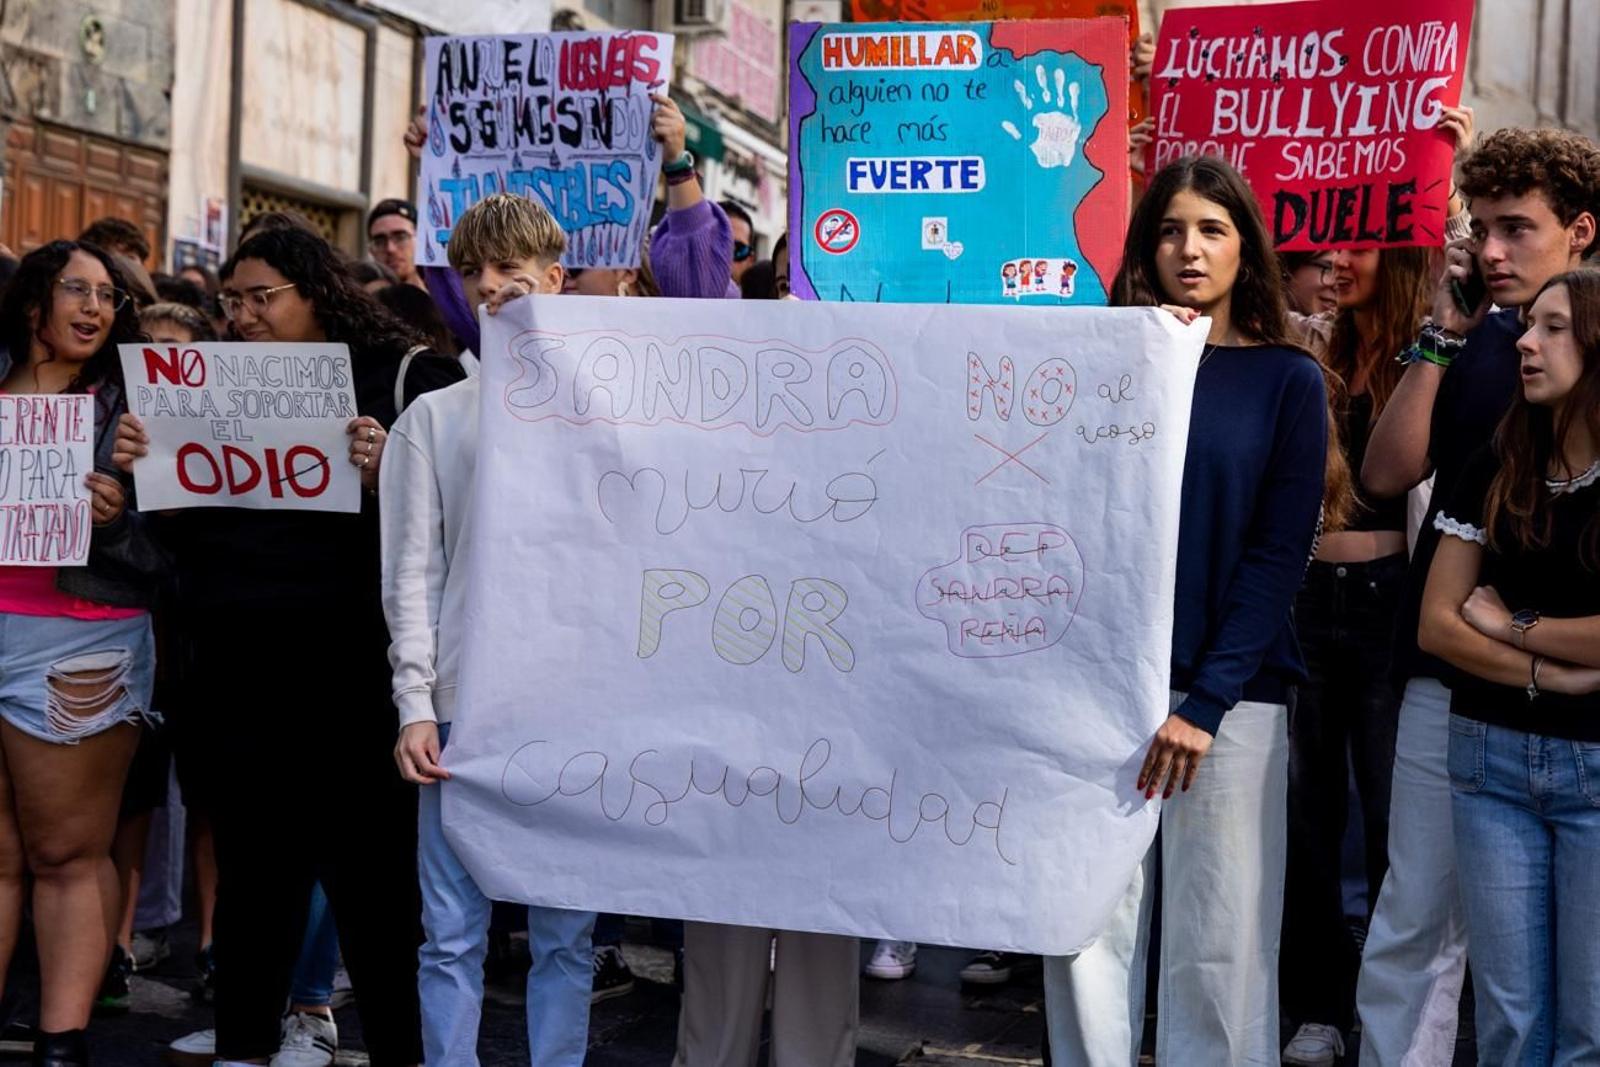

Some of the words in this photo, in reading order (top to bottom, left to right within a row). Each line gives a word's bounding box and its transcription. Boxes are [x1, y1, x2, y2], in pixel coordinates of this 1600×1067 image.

[823, 35, 978, 68] HUMILLAR
[987, 52, 1009, 67] a
[1156, 28, 1346, 79] LUCHAMOS
[1363, 21, 1459, 76] CONTRA
[829, 79, 911, 117] alguien
[922, 83, 949, 101] no
[964, 79, 987, 99] te
[1158, 92, 1184, 137] EL
[1210, 75, 1452, 138] BULLYING
[821, 113, 871, 144] hace
[898, 114, 948, 143] más
[849, 160, 980, 190] FUERTE
[1275, 138, 1406, 181] SABEMOS
[1272, 178, 1418, 249] DUELE
[213, 355, 348, 389] NACIMOS
[507, 336, 887, 428] SANDRA
[966, 351, 1077, 427] NO
[1097, 374, 1135, 404] al
[138, 385, 220, 418] PARA
[226, 390, 355, 418] SOPORTAR
[210, 420, 253, 441] EL
[1076, 421, 1155, 445] acoso
[19, 447, 79, 501] PARA
[177, 442, 330, 498] ODIO
[925, 574, 1074, 607] SANDRA
[637, 568, 856, 673] POR
[501, 738, 1016, 866] casualidad
